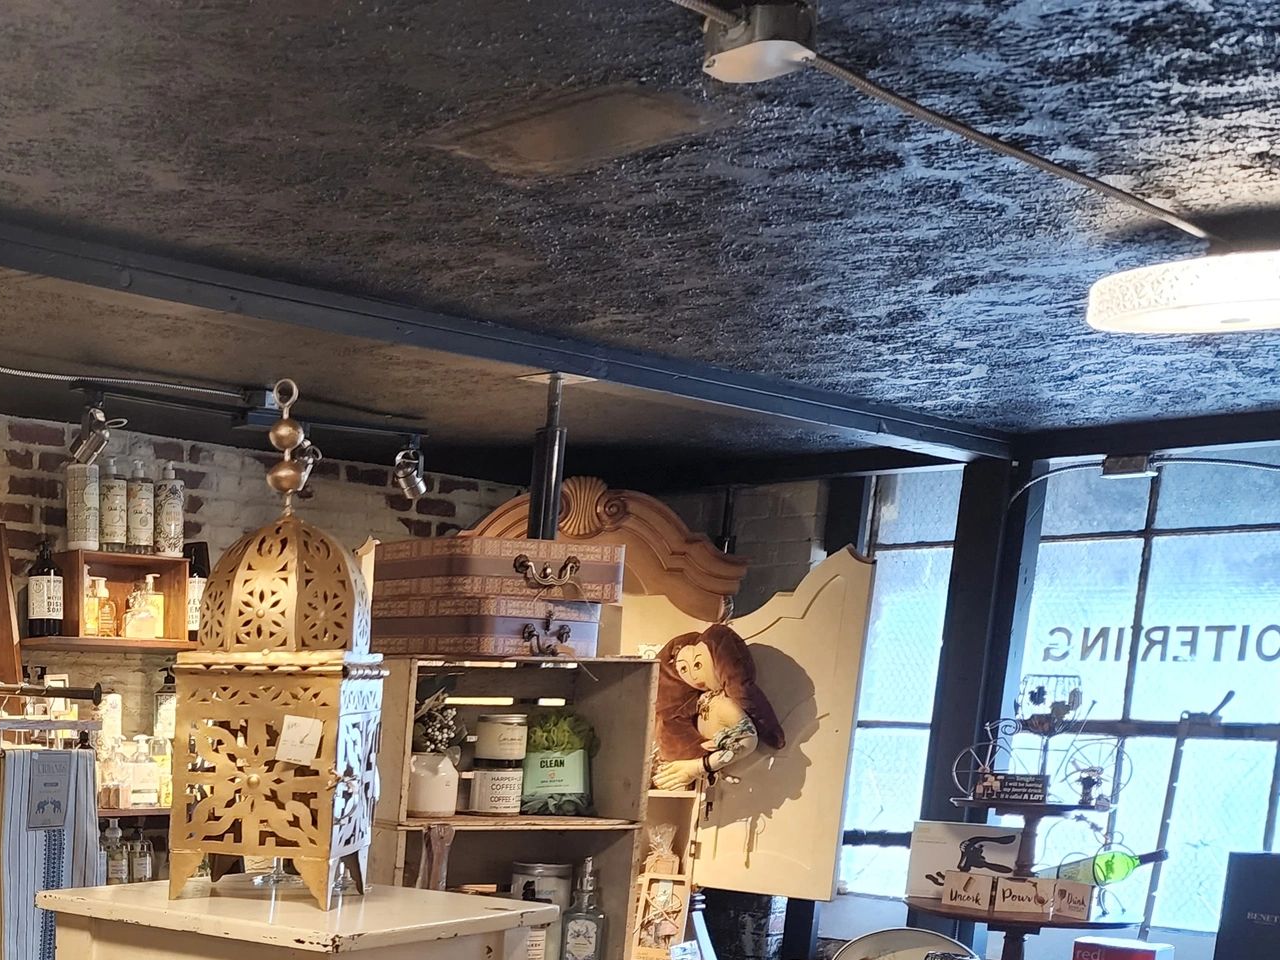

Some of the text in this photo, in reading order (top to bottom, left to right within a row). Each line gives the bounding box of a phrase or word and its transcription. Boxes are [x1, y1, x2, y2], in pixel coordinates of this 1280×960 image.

[540, 759, 565, 768] CLEAN
[1030, 793, 1045, 801] LOT
[949, 887, 982, 906] Uncork
[1001, 887, 1032, 903] Pour
